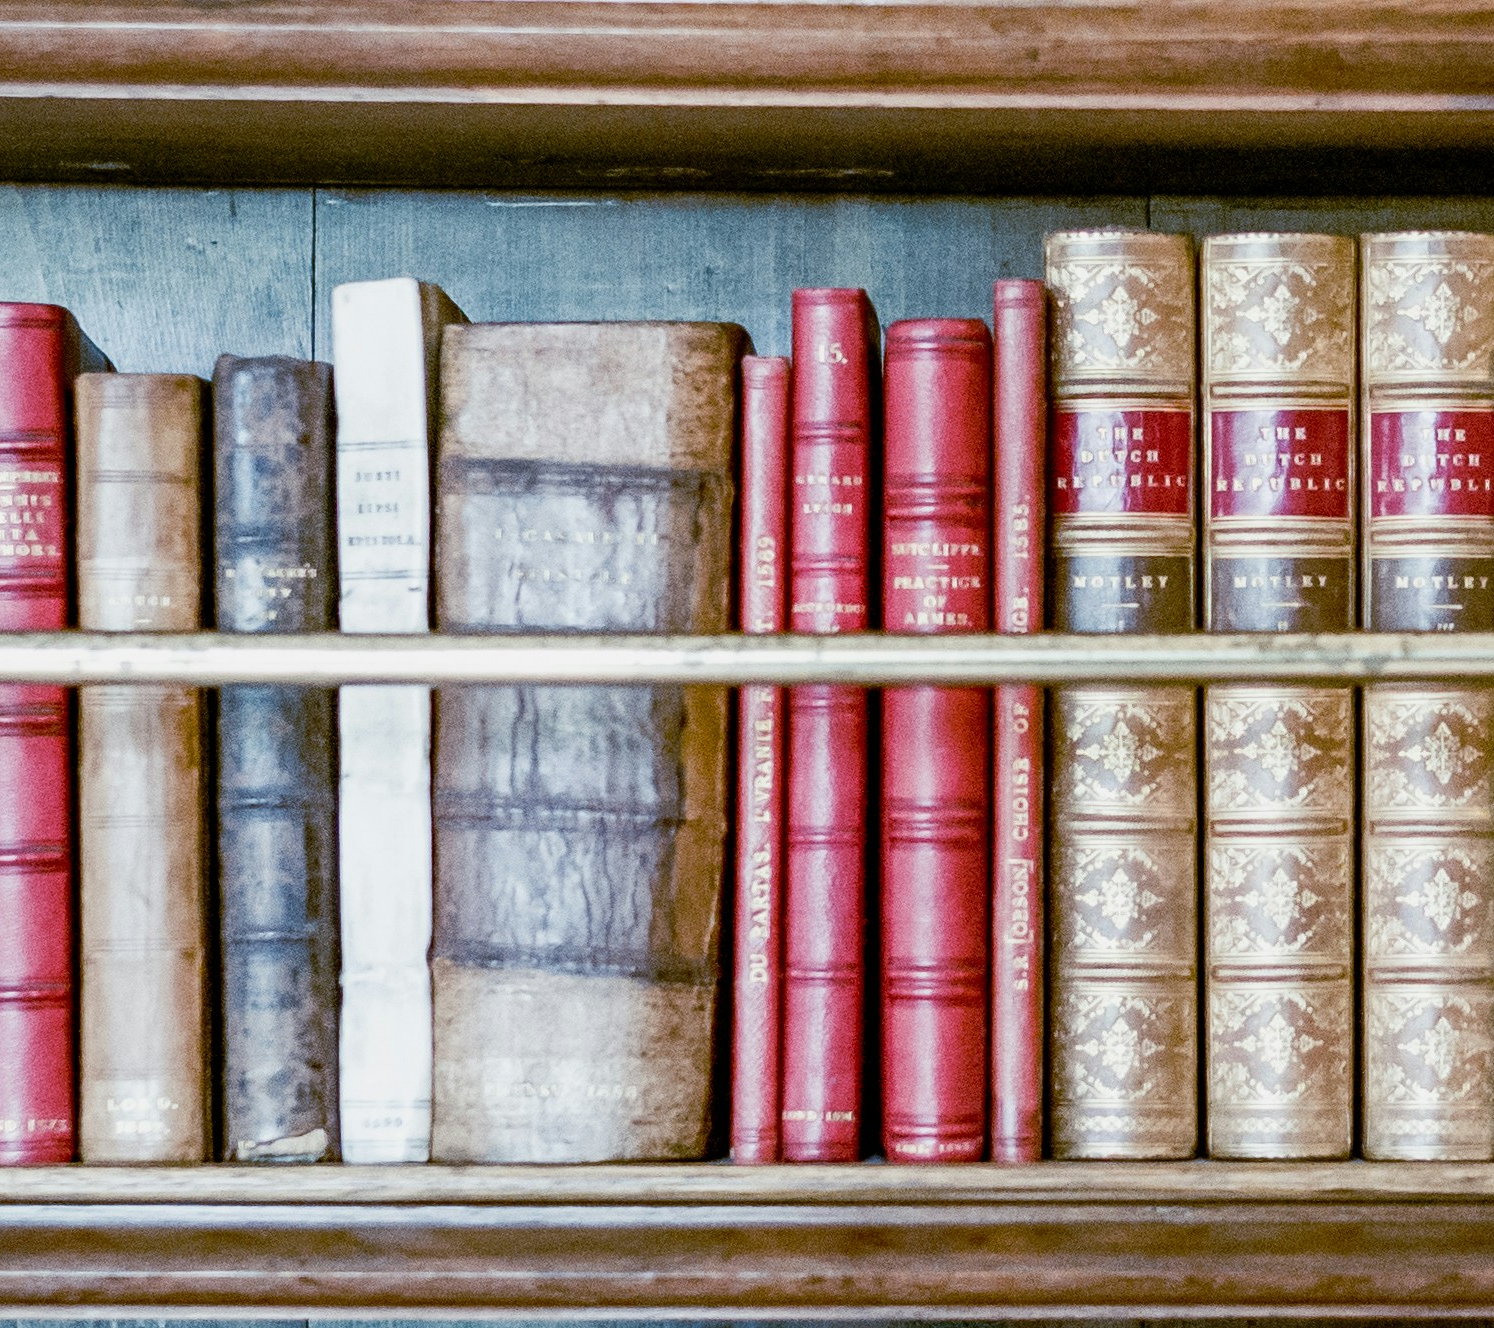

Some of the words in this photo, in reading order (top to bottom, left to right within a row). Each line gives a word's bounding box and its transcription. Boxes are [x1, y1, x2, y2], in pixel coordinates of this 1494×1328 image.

[818, 343, 848, 365] 15.
[1096, 426, 1143, 440] THE
[1259, 426, 1306, 441] THE
[1422, 427, 1466, 442] THE
[1081, 449, 1159, 463] DUTCH
[1245, 452, 1322, 467] DUTCH
[1403, 452, 1480, 467] DUTCH
[1057, 473, 1186, 488] REPUBLIC
[1216, 477, 1345, 492] REPUBLIC
[758, 537, 774, 587] 1589
[1074, 575, 1168, 589] MOTLEY
[1234, 575, 1327, 589] MOTLEY
[1396, 575, 1488, 589] MOTLEY
[923, 595, 946, 608] OF
[1013, 703, 1029, 733] OF
[749, 954, 768, 983] DU
